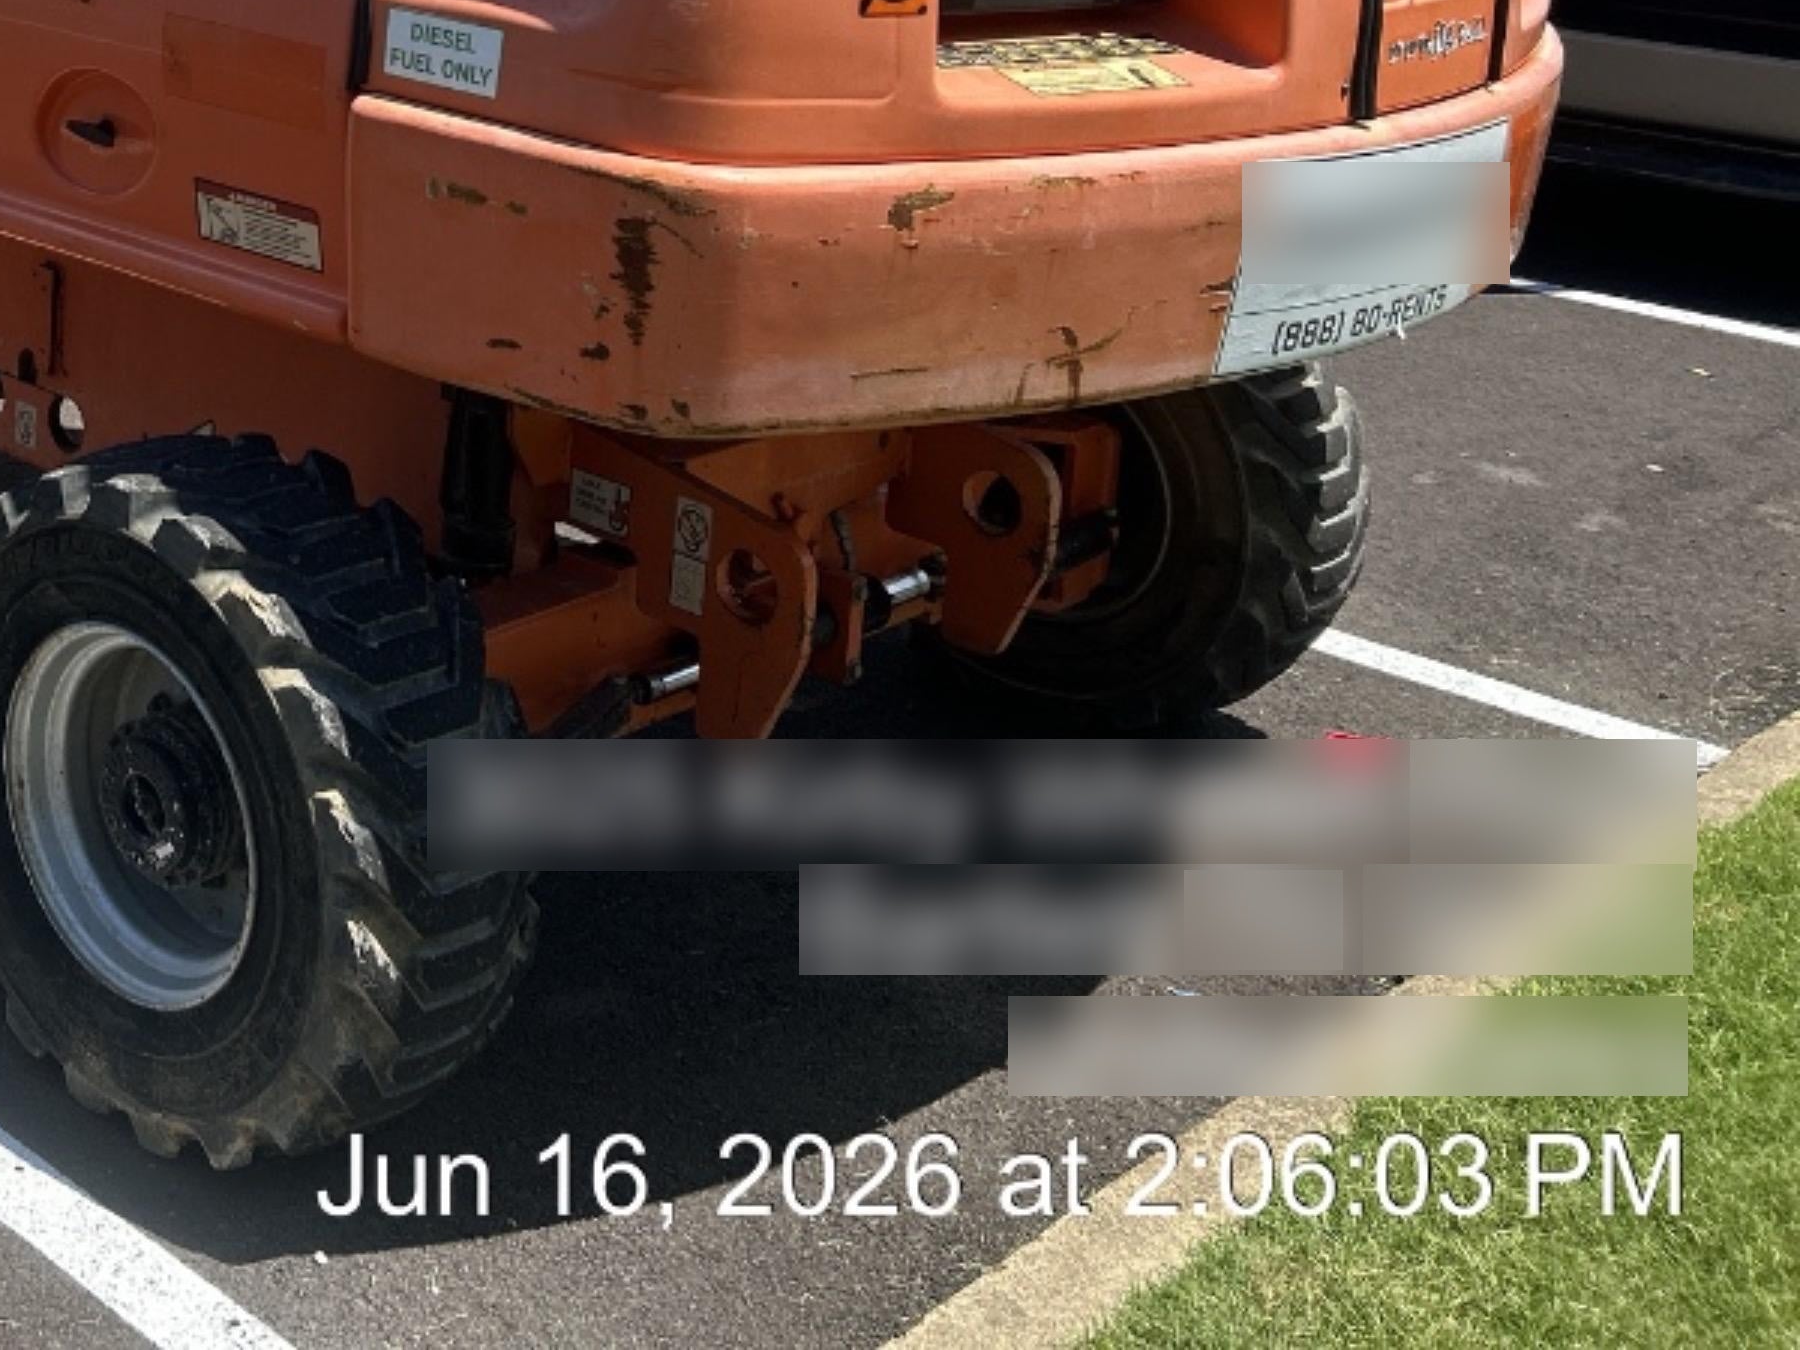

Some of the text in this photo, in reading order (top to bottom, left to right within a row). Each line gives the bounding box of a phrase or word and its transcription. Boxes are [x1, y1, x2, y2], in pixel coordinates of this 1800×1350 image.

[410, 22, 477, 55] DIESEL
[390, 47, 493, 88] FUEL ONLY
[1272, 308, 1346, 356] (888)
